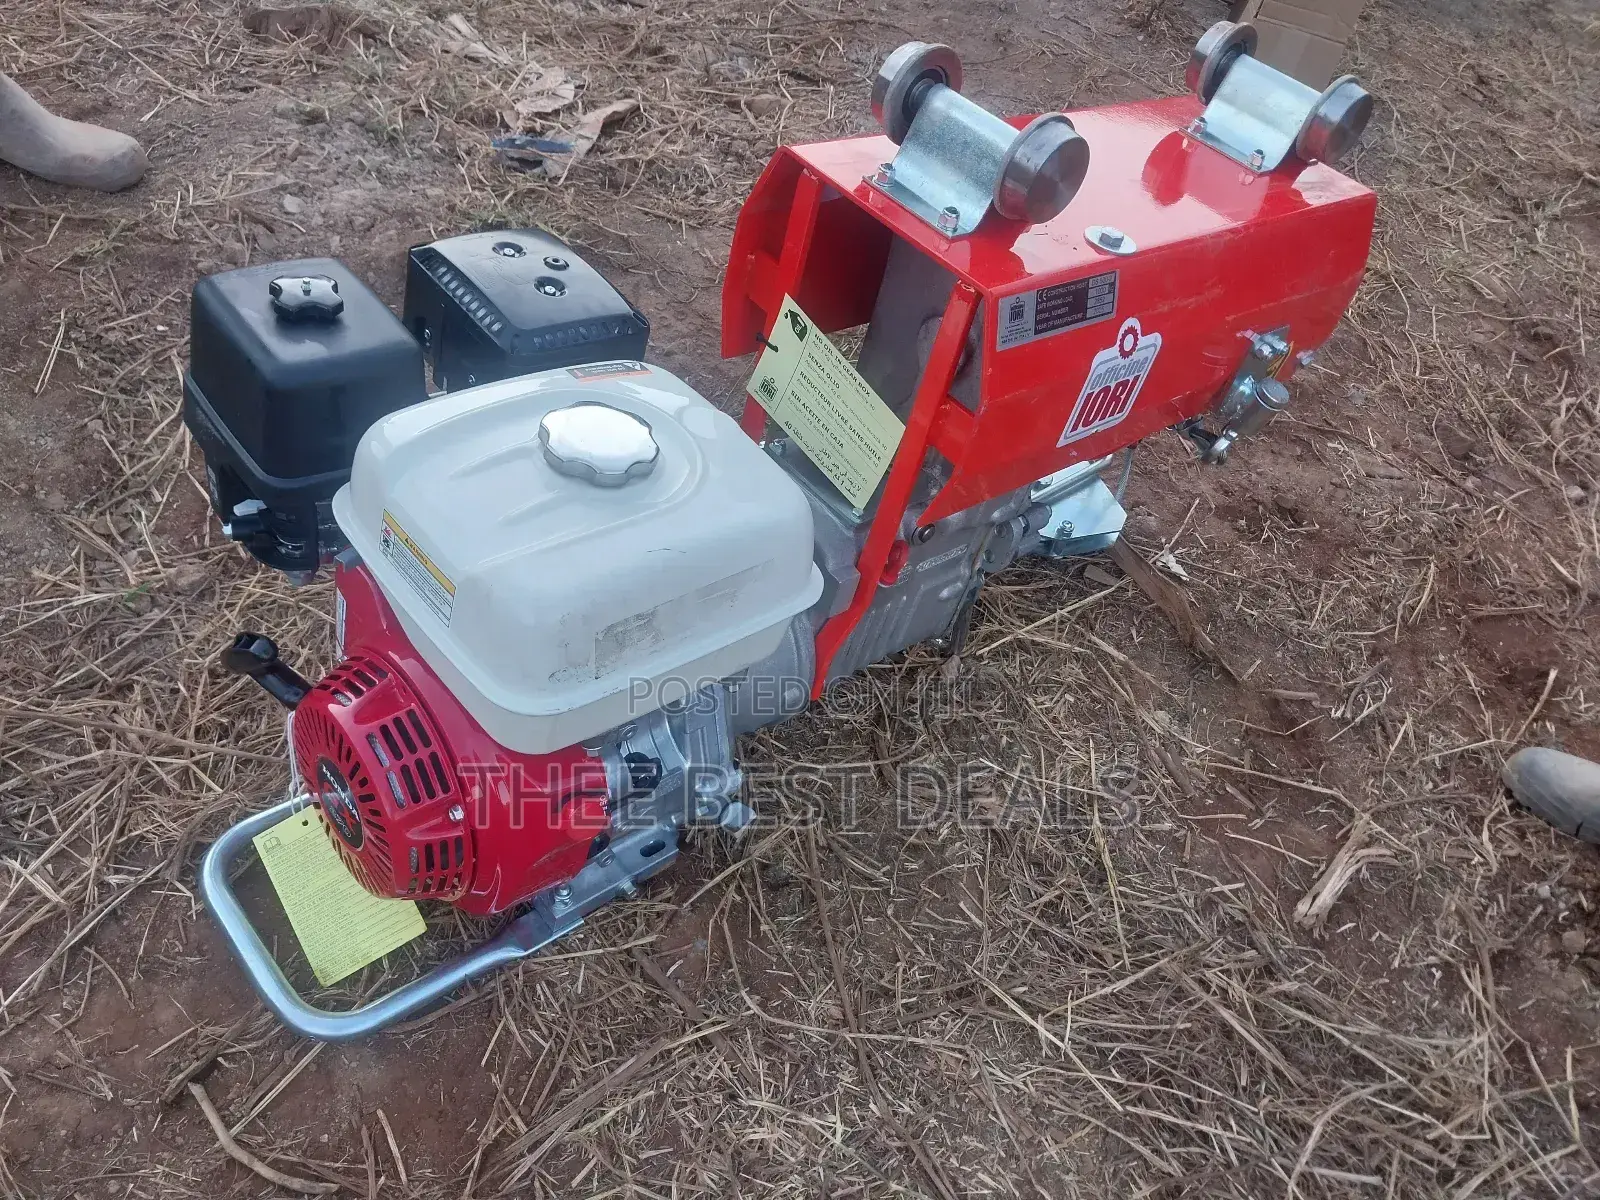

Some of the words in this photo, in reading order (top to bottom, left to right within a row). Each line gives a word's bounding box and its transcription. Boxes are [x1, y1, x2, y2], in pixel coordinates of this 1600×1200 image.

[760, 381, 774, 399] IORI
[807, 351, 825, 373] SENZA
[825, 371, 840, 389] OLIO
[814, 332, 823, 344] NO
[823, 342, 834, 356] OIL
[834, 355, 842, 365] IN
[842, 363, 857, 382] GEAR
[857, 381, 870, 397] BOX
[1090, 356, 1149, 391] officine
[783, 418, 792, 430] 40
[790, 389, 801, 403] SIN
[801, 401, 821, 424] ACEITE
[821, 422, 829, 433] EN
[829, 431, 844, 448] CAJA
[799, 370, 831, 407] REDUCTEUR
[848, 424, 864, 443] SANS
[863, 440, 882, 462] HUILE
[1070, 374, 1142, 433] IORI
[322, 764, 360, 822] HONDA
